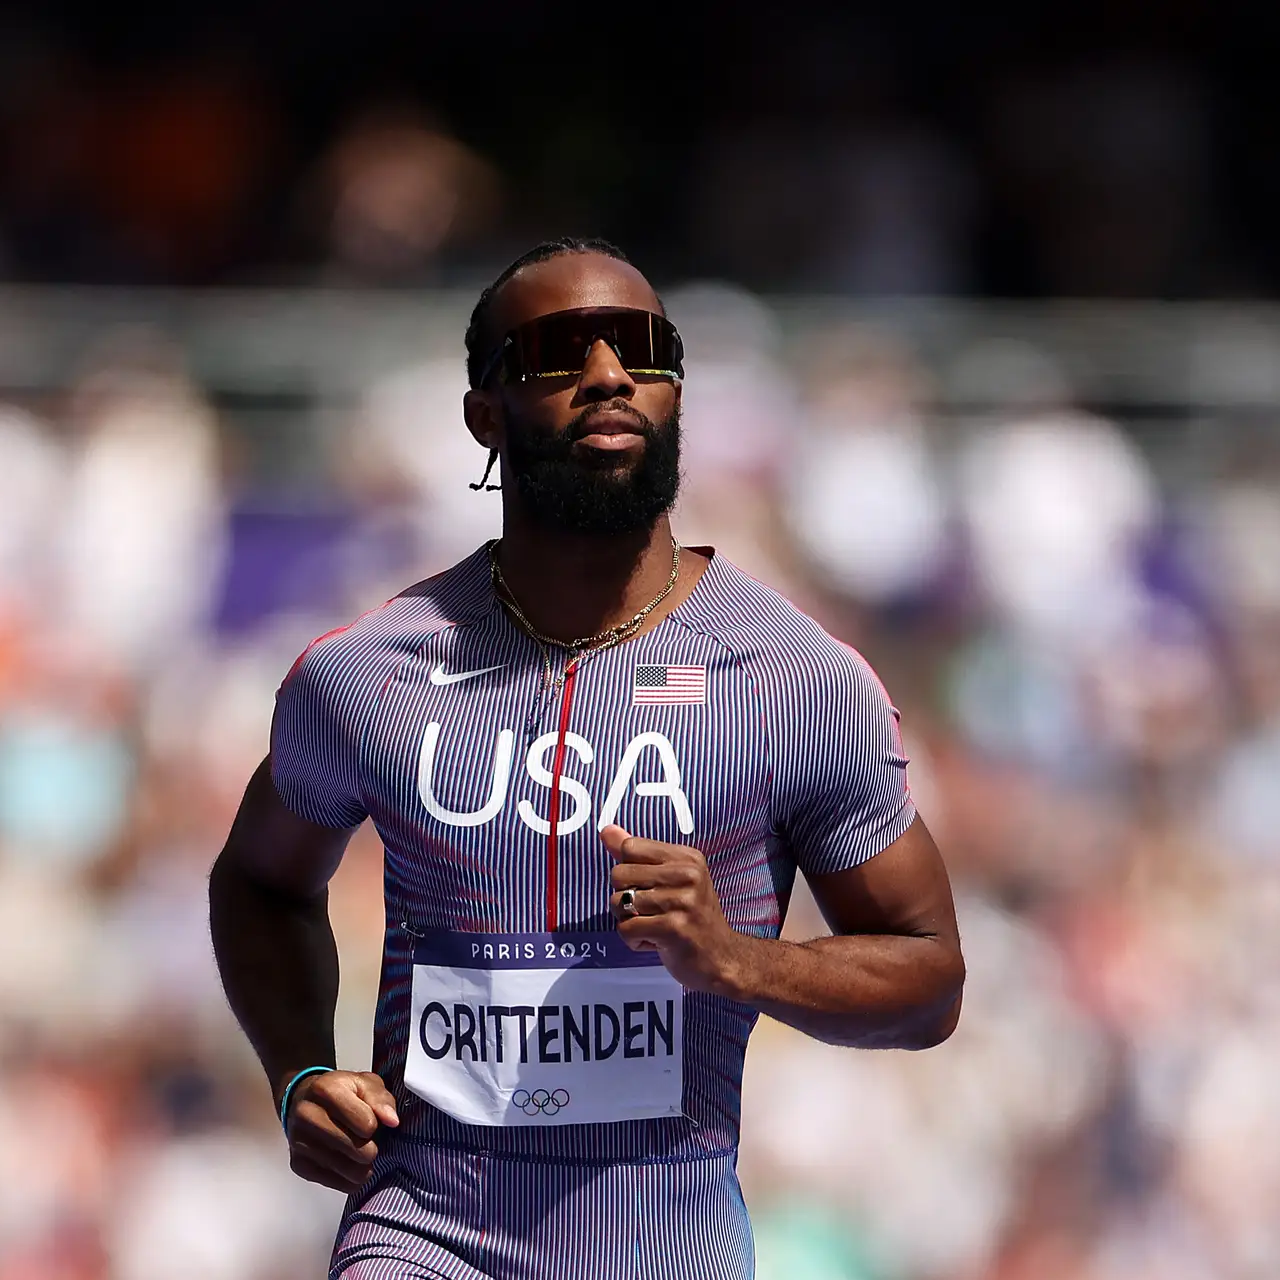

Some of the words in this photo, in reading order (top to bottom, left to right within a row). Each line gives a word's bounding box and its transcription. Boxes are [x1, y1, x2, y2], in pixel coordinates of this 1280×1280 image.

[418, 722, 694, 837] USA
[544, 942, 607, 958] 2024
[419, 999, 674, 1064] CRITTENDEN
